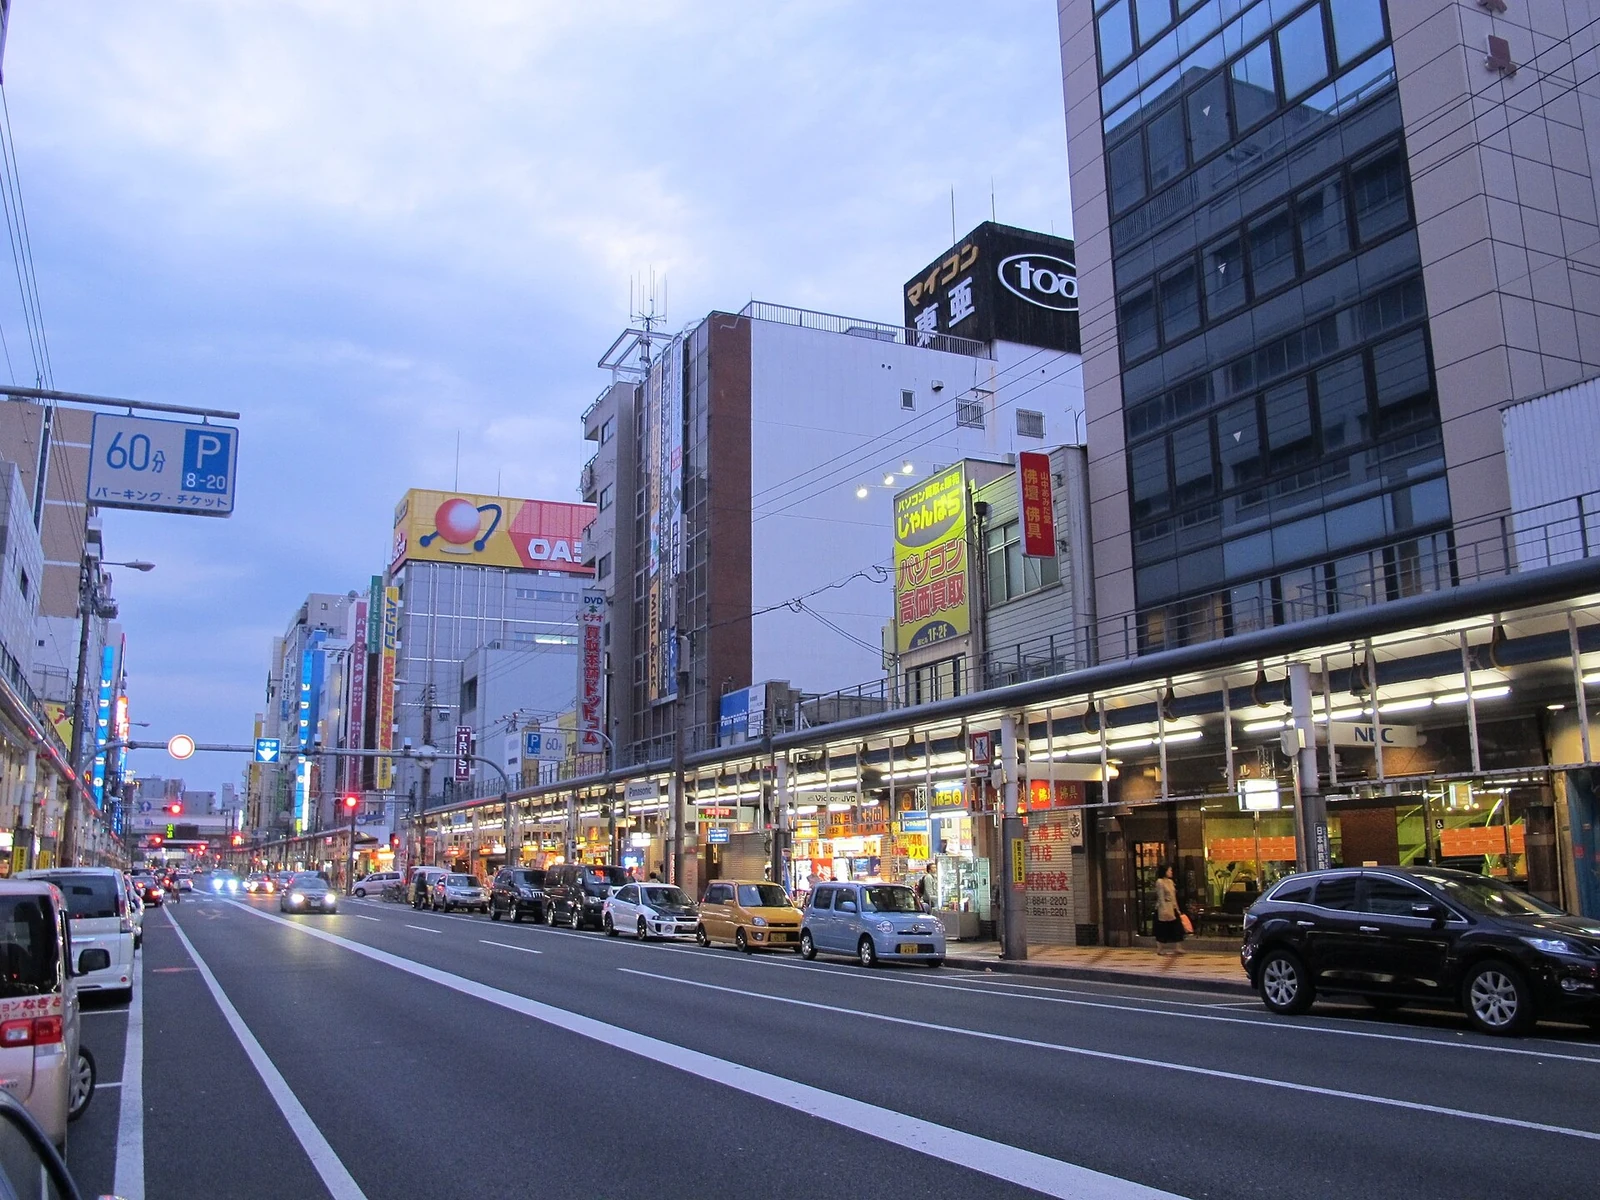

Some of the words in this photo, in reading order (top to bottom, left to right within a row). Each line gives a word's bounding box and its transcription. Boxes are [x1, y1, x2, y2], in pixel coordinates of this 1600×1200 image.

[907, 243, 979, 307] マイコン
[196, 435, 222, 470] P
[185, 472, 226, 490] 8-20
[95, 486, 228, 508] パーキング・チケット
[1026, 506, 1042, 539] 佛具
[898, 538, 965, 590] パソコン
[584, 596, 603, 605] DVD
[899, 572, 966, 626] 高価買取
[583, 613, 604, 622] ビデオ
[531, 735, 539, 746] P
[629, 784, 652, 796] Panasonic
[815, 794, 838, 802] Vicor
